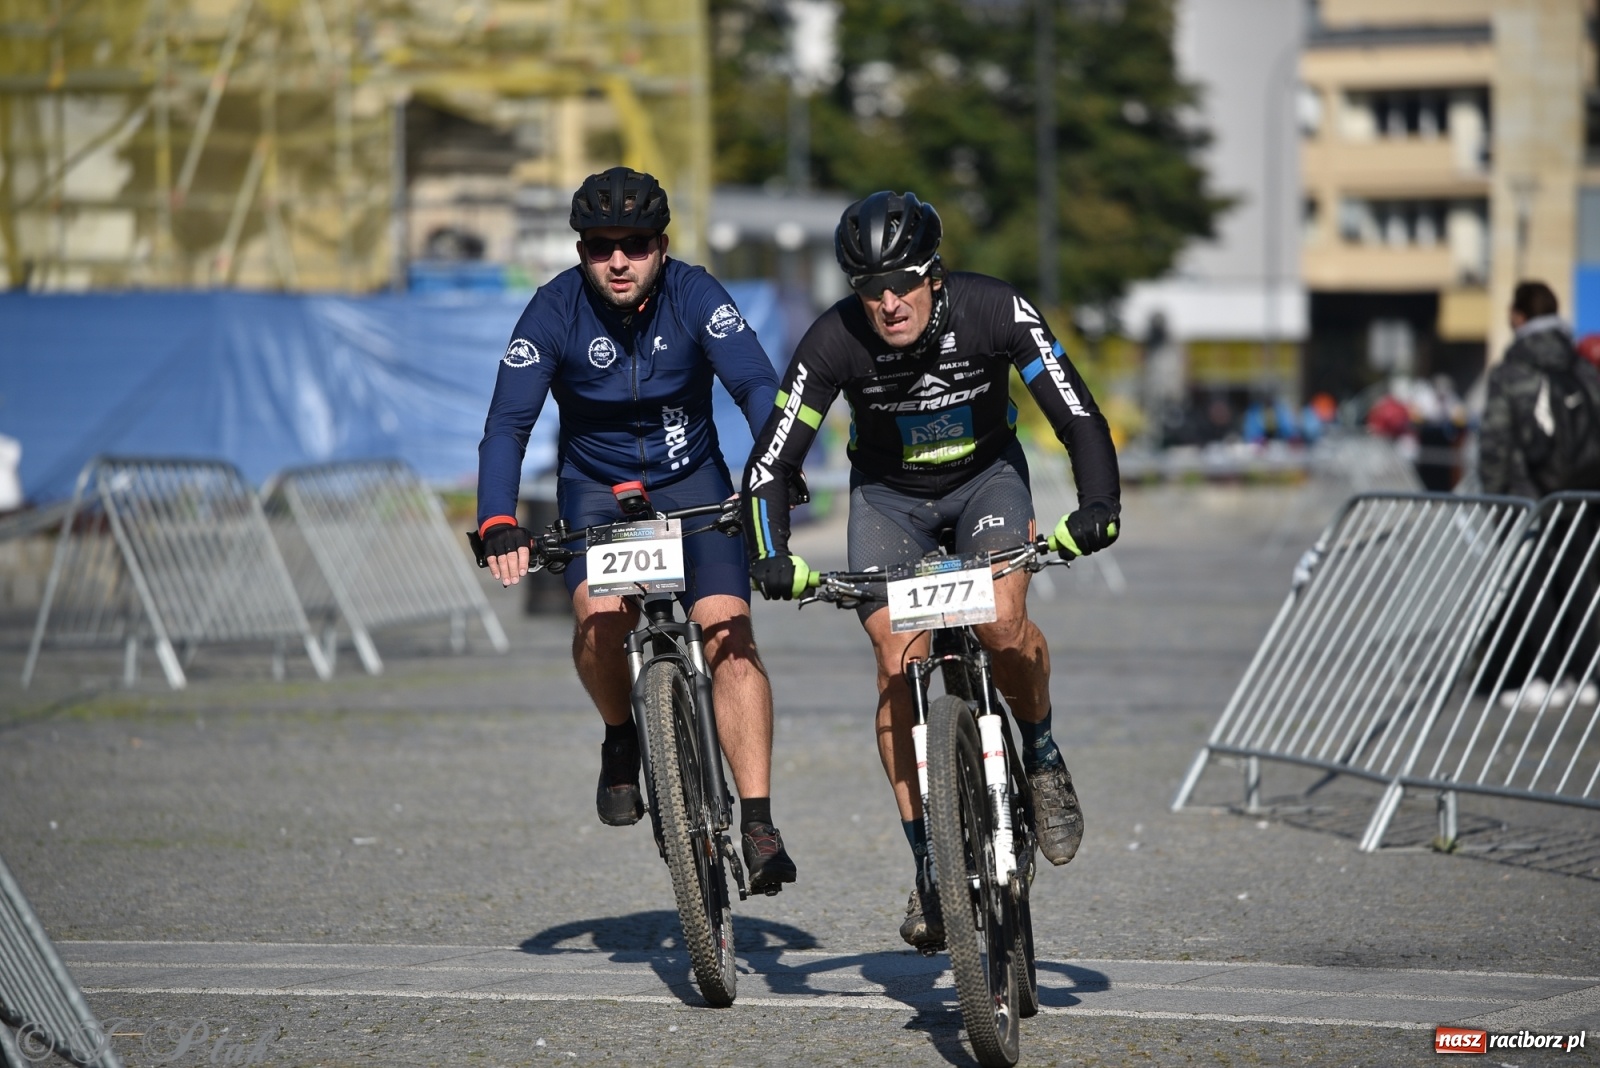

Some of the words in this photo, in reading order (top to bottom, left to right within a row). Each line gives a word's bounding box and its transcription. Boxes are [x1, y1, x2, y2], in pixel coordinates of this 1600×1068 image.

[876, 352, 904, 362] CST
[939, 360, 970, 370] MAXXIS
[879, 371, 914, 380] DIADORA
[1029, 327, 1091, 417] MERIDA
[868, 382, 992, 413] MERIDA
[761, 362, 808, 466] MERIDA
[602, 548, 667, 575] 2701
[907, 579, 975, 609] 1777
